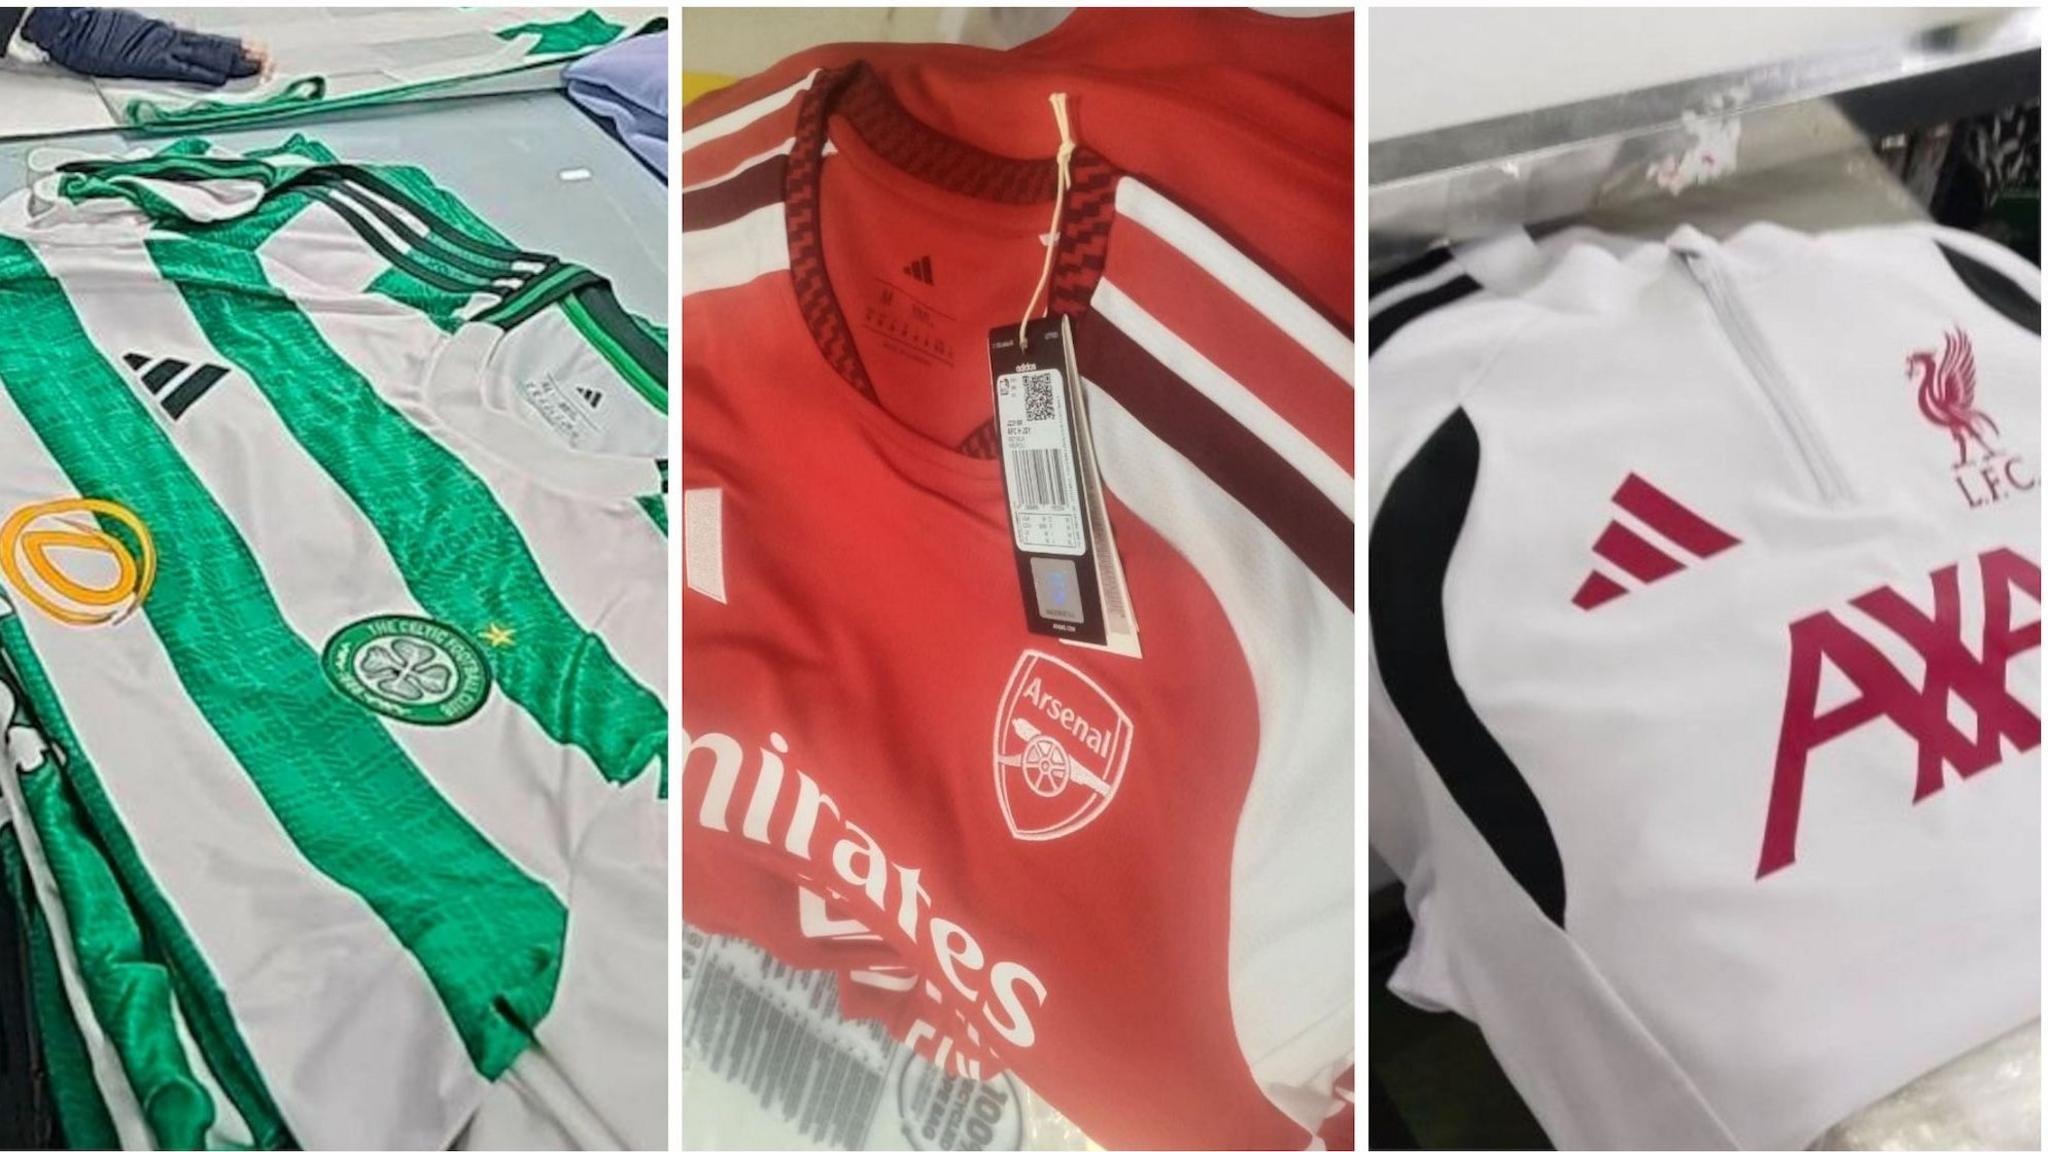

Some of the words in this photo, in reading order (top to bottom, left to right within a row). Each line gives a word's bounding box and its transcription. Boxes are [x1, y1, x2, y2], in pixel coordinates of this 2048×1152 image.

[367, 620, 396, 636] THE
[399, 620, 449, 642] CELTIC
[445, 639, 481, 696] FOOTBALL
[439, 694, 476, 718] CLUB
[1023, 677, 1112, 758] Arsenal
[1755, 546, 2041, 881] AXA
